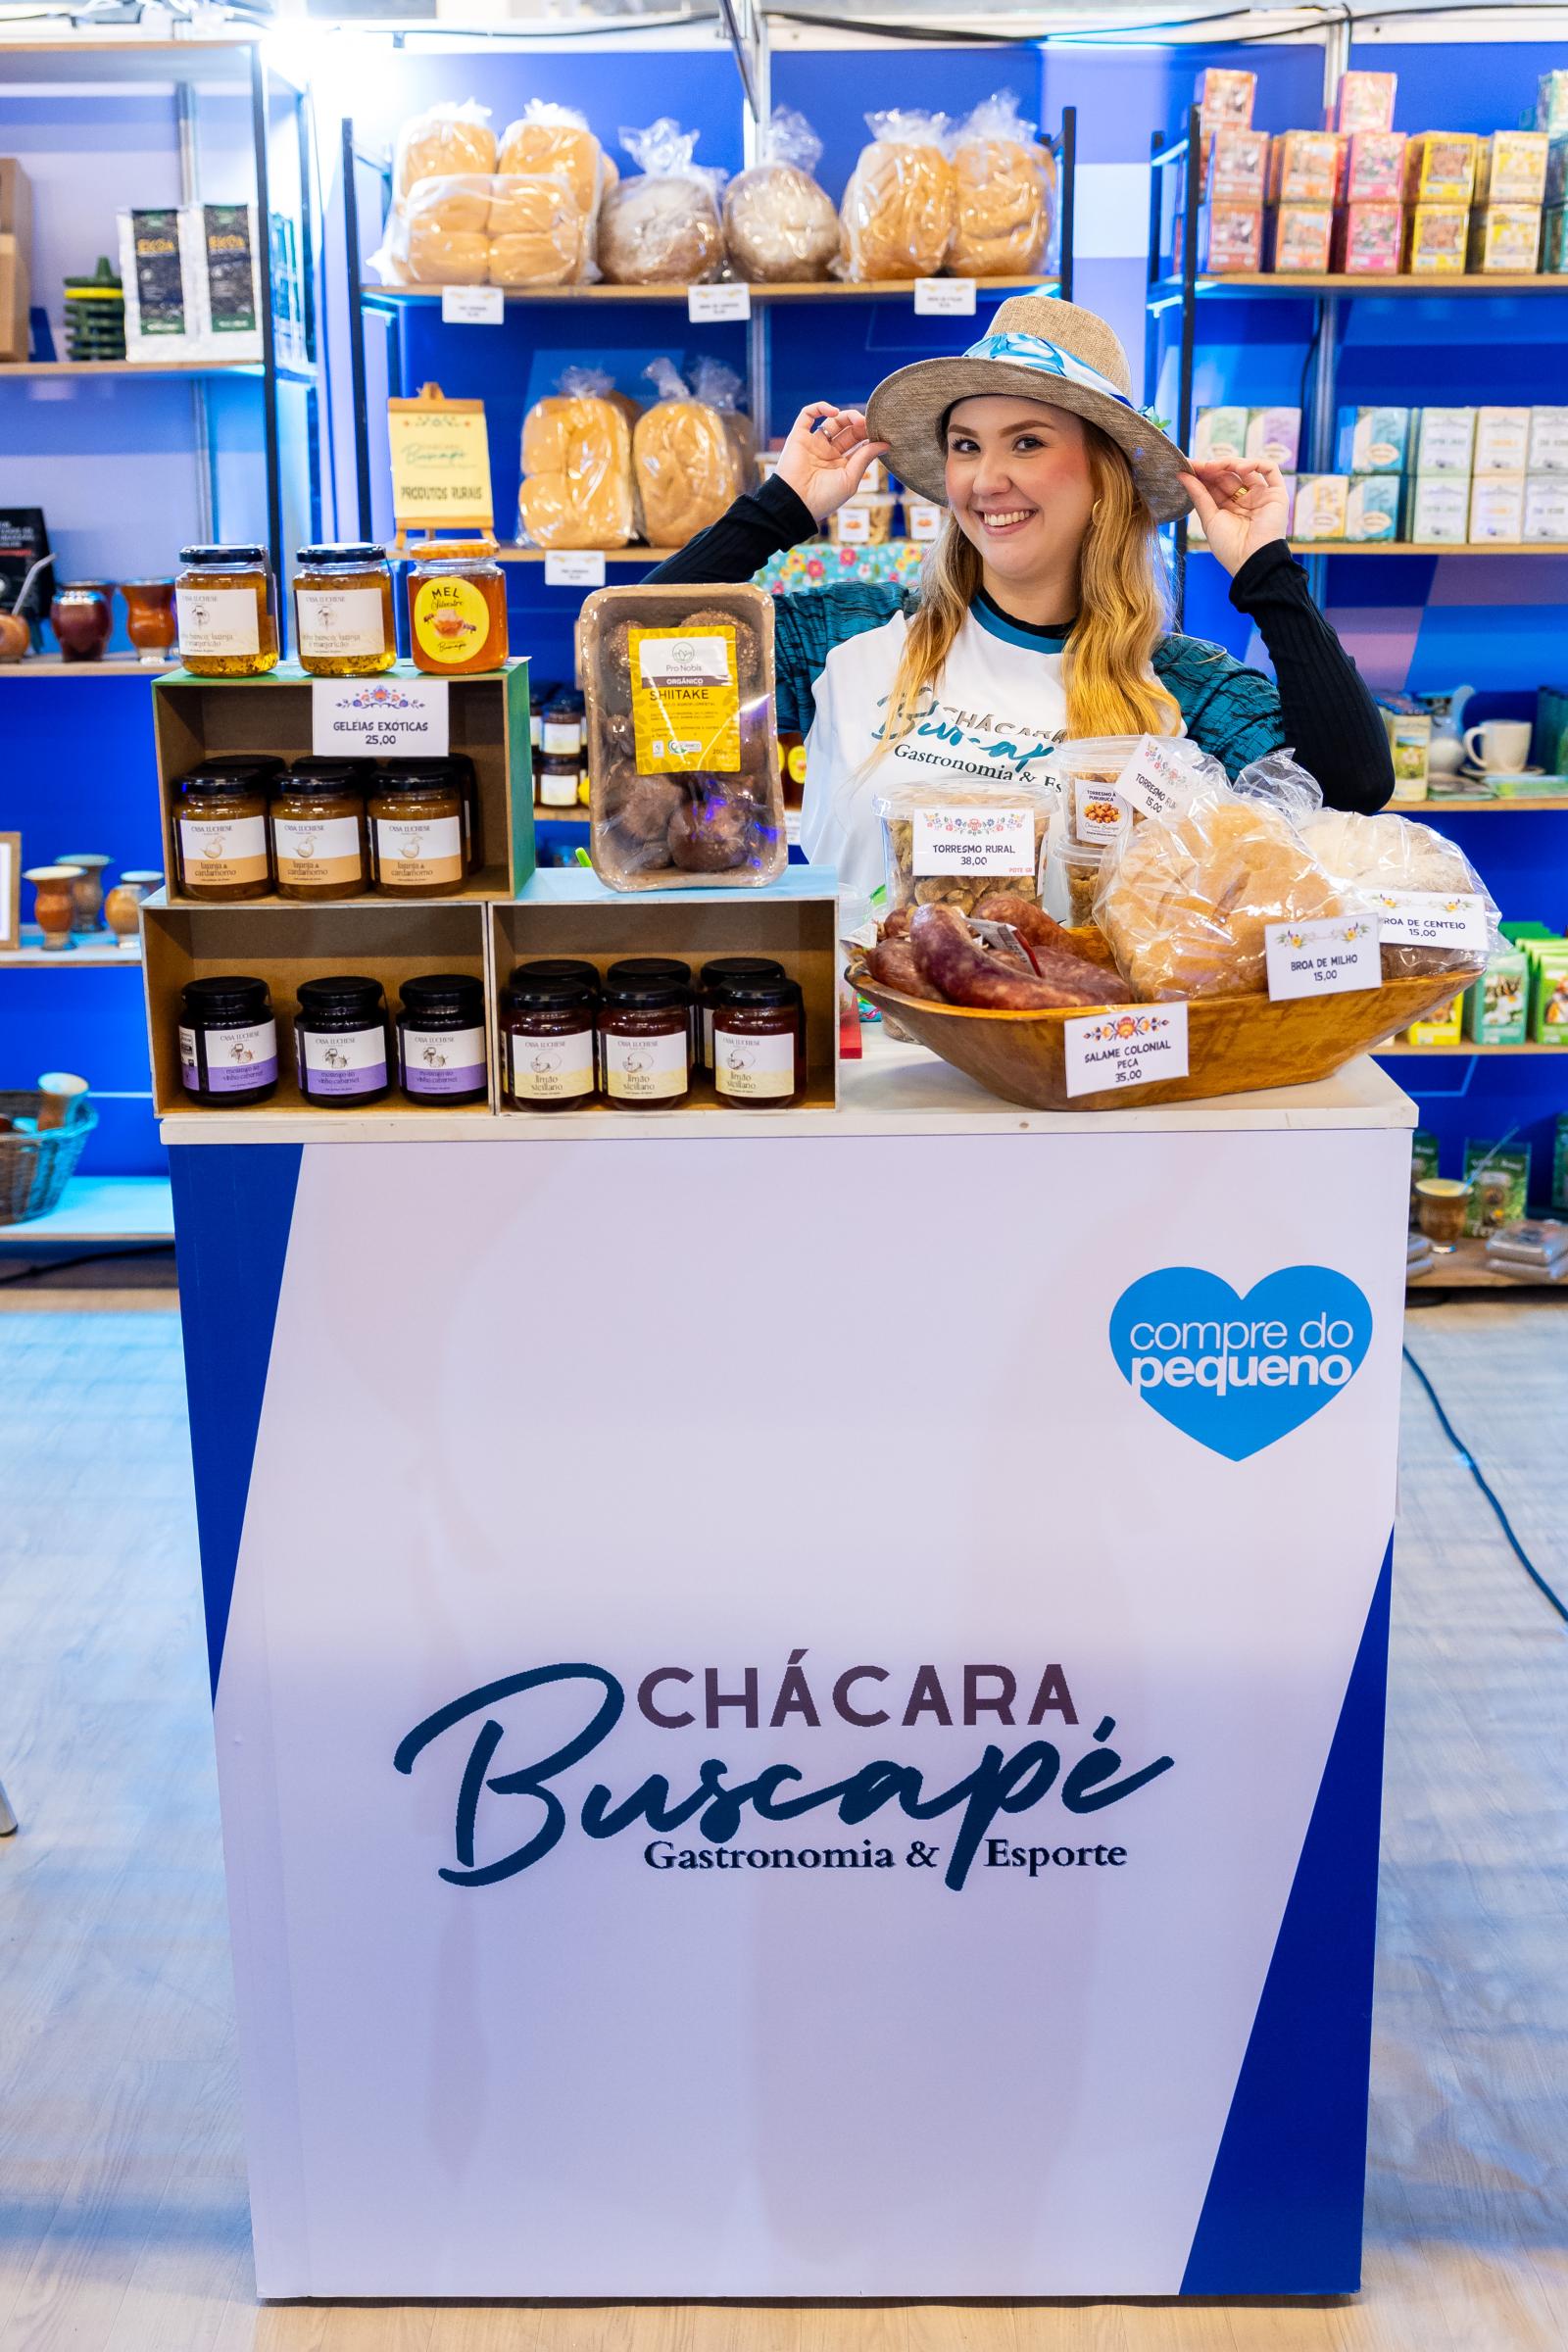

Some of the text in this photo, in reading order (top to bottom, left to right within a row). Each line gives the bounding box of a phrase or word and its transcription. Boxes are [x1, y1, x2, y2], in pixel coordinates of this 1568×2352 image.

[401, 486, 482, 500] PRODUTOS RURAIS
[431, 587, 460, 600] MEL
[666, 676, 704, 686] ORGÂNICO
[650, 689, 710, 702] SHIITAKE
[894, 744, 1013, 781] Gastronomia
[1019, 771, 1038, 782] &
[1136, 772, 1166, 802] TORRESMO
[933, 845, 1015, 854] TORRESMO RURAL
[960, 857, 988, 866] 38,00
[1407, 918, 1420, 927] DE
[1423, 919, 1466, 930] CENTEIO
[1291, 954, 1358, 972] BROA DE MILHO
[1084, 1040, 1171, 1063] SALAME COLONIAL
[535, 1074, 559, 1084] limão
[627, 1074, 650, 1083] limão
[731, 1071, 752, 1081] limão
[531, 1083, 563, 1092] siciliano
[1130, 1311, 1354, 1356] compre do
[1131, 1354, 1352, 1396] pequeno
[637, 1647, 1080, 1730] CHÁCARA
[391, 1662, 1176, 1891] Buscapé
[643, 1838, 1128, 1877] Gastronomia & Esporte
